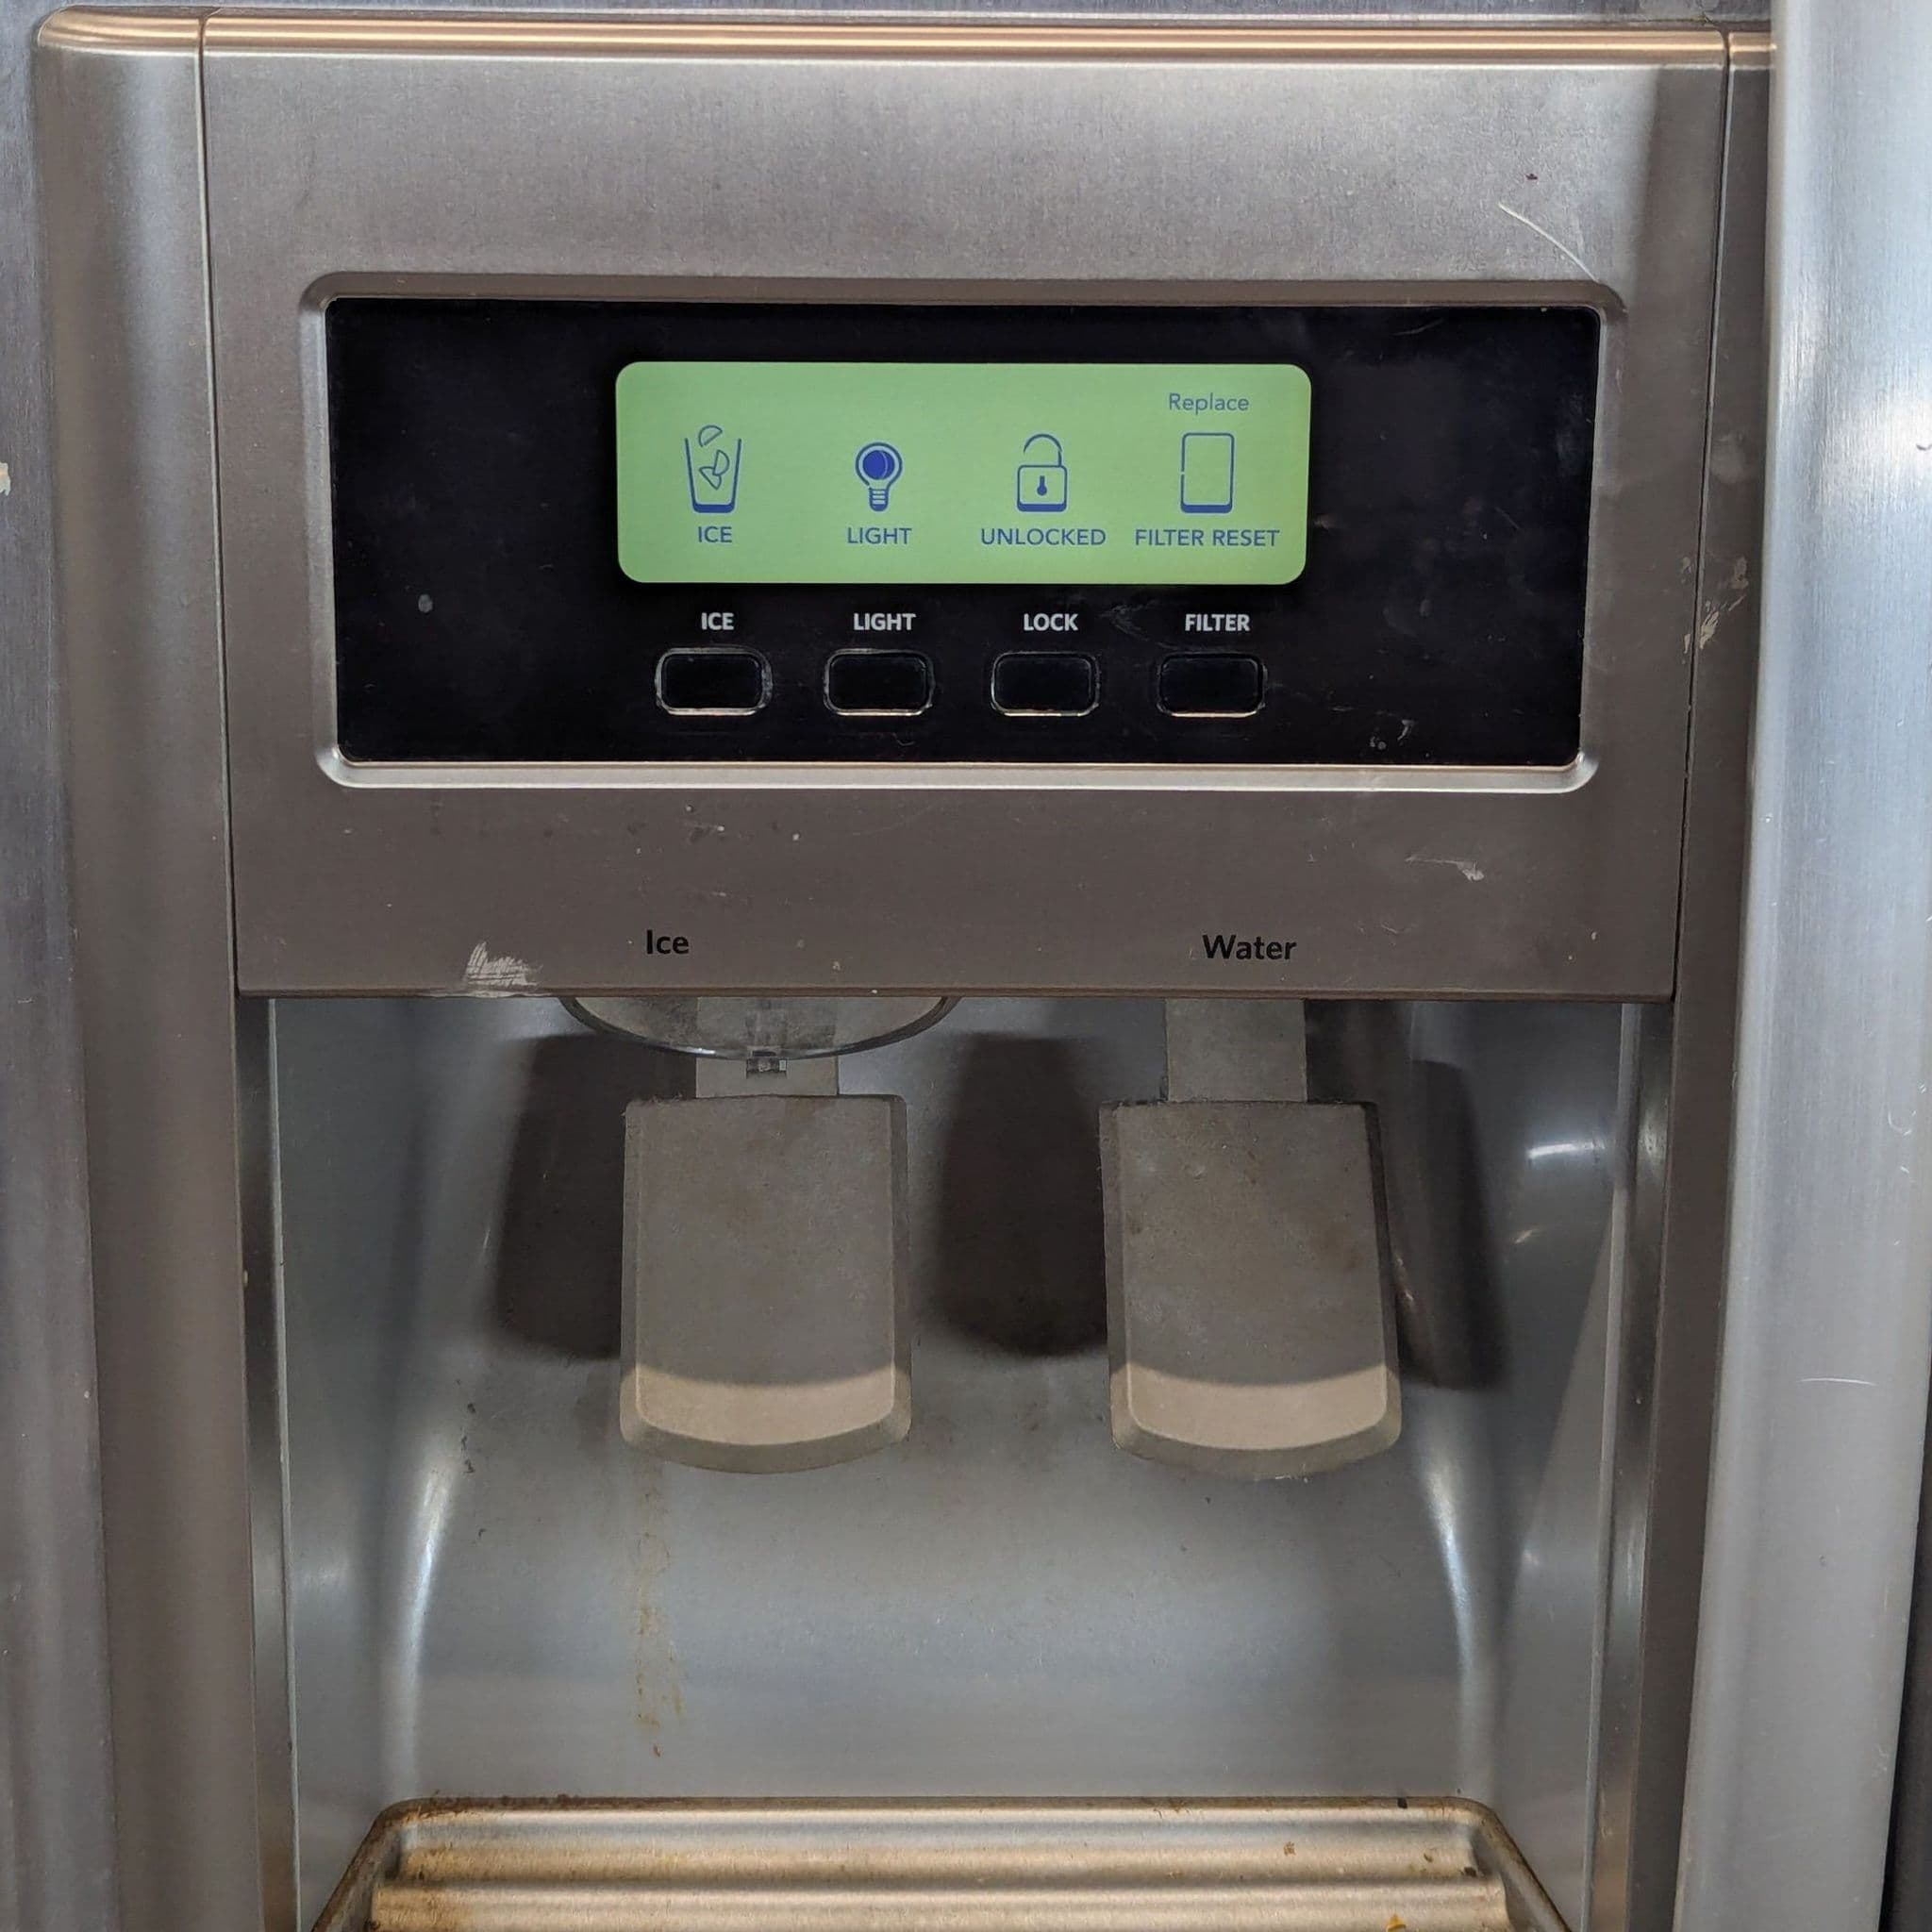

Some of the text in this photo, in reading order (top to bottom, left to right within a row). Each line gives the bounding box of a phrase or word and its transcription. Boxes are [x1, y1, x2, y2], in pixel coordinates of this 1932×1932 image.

[1170, 392, 1249, 415] Replace
[698, 526, 732, 542] ICE
[848, 527, 911, 544] LIGHT
[982, 528, 1106, 545] UNLOCKED
[1136, 529, 1279, 546] FILTER RESET
[702, 612, 734, 630] ICE
[854, 613, 916, 630] LIGHT
[1024, 613, 1078, 631] LOCK
[1186, 614, 1249, 631] FILTER
[647, 930, 689, 954] Ice
[1203, 935, 1296, 959] Water
